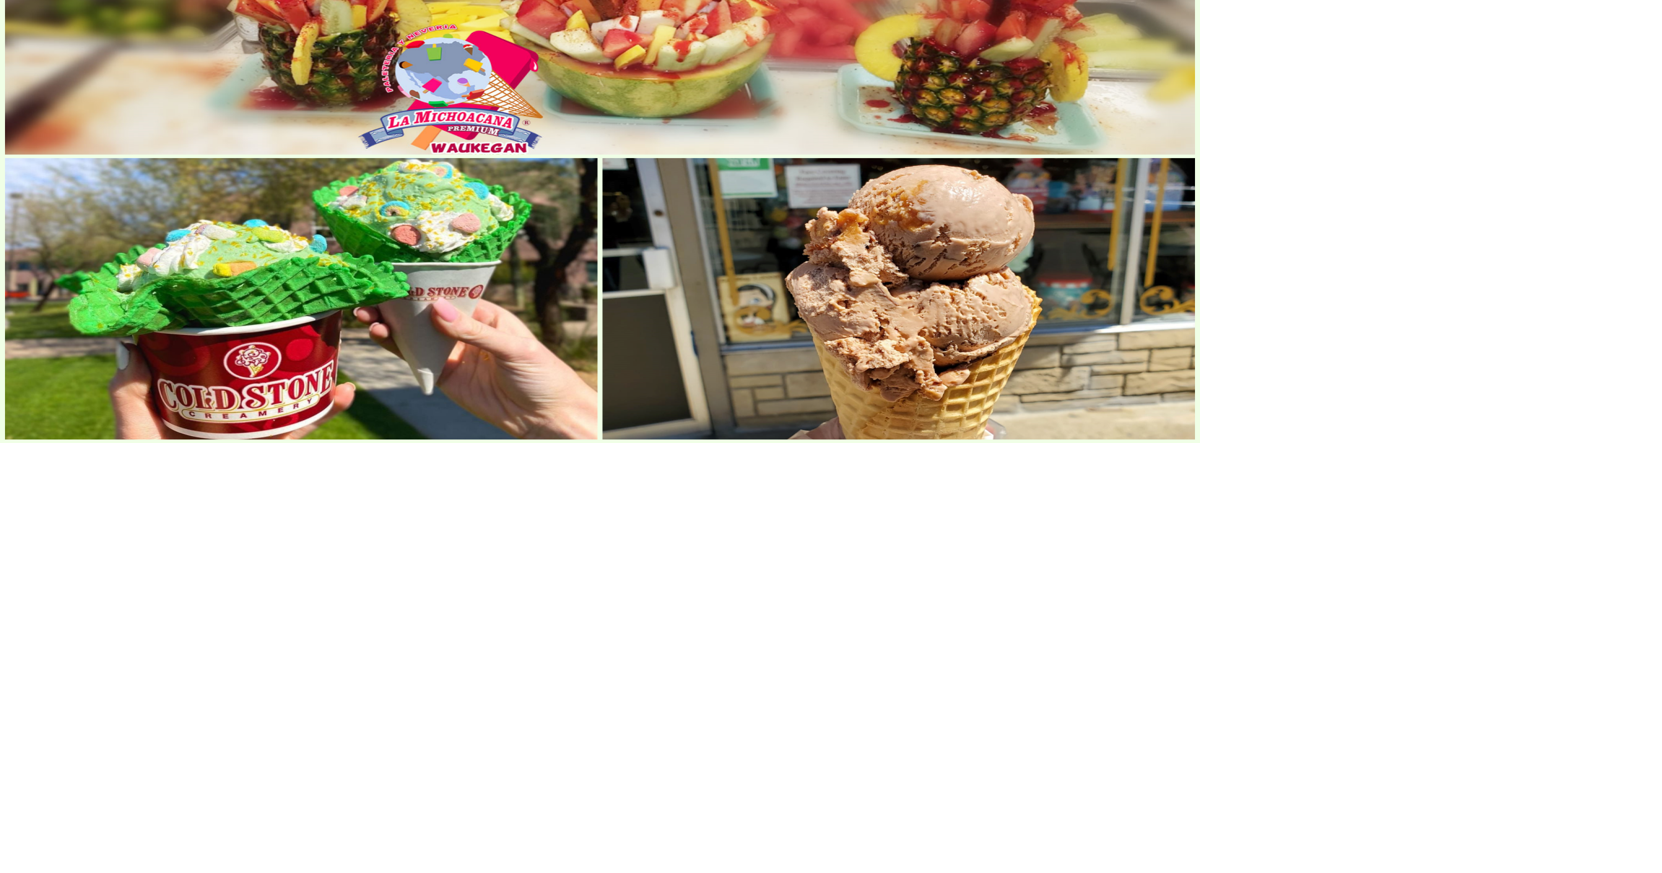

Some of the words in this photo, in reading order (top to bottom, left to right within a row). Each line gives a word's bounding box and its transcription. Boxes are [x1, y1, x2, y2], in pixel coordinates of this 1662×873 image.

[427, 287, 469, 298] STONE
[157, 378, 241, 412] COLD
[243, 362, 333, 410] STONE
[188, 398, 313, 419] CREAMERY
